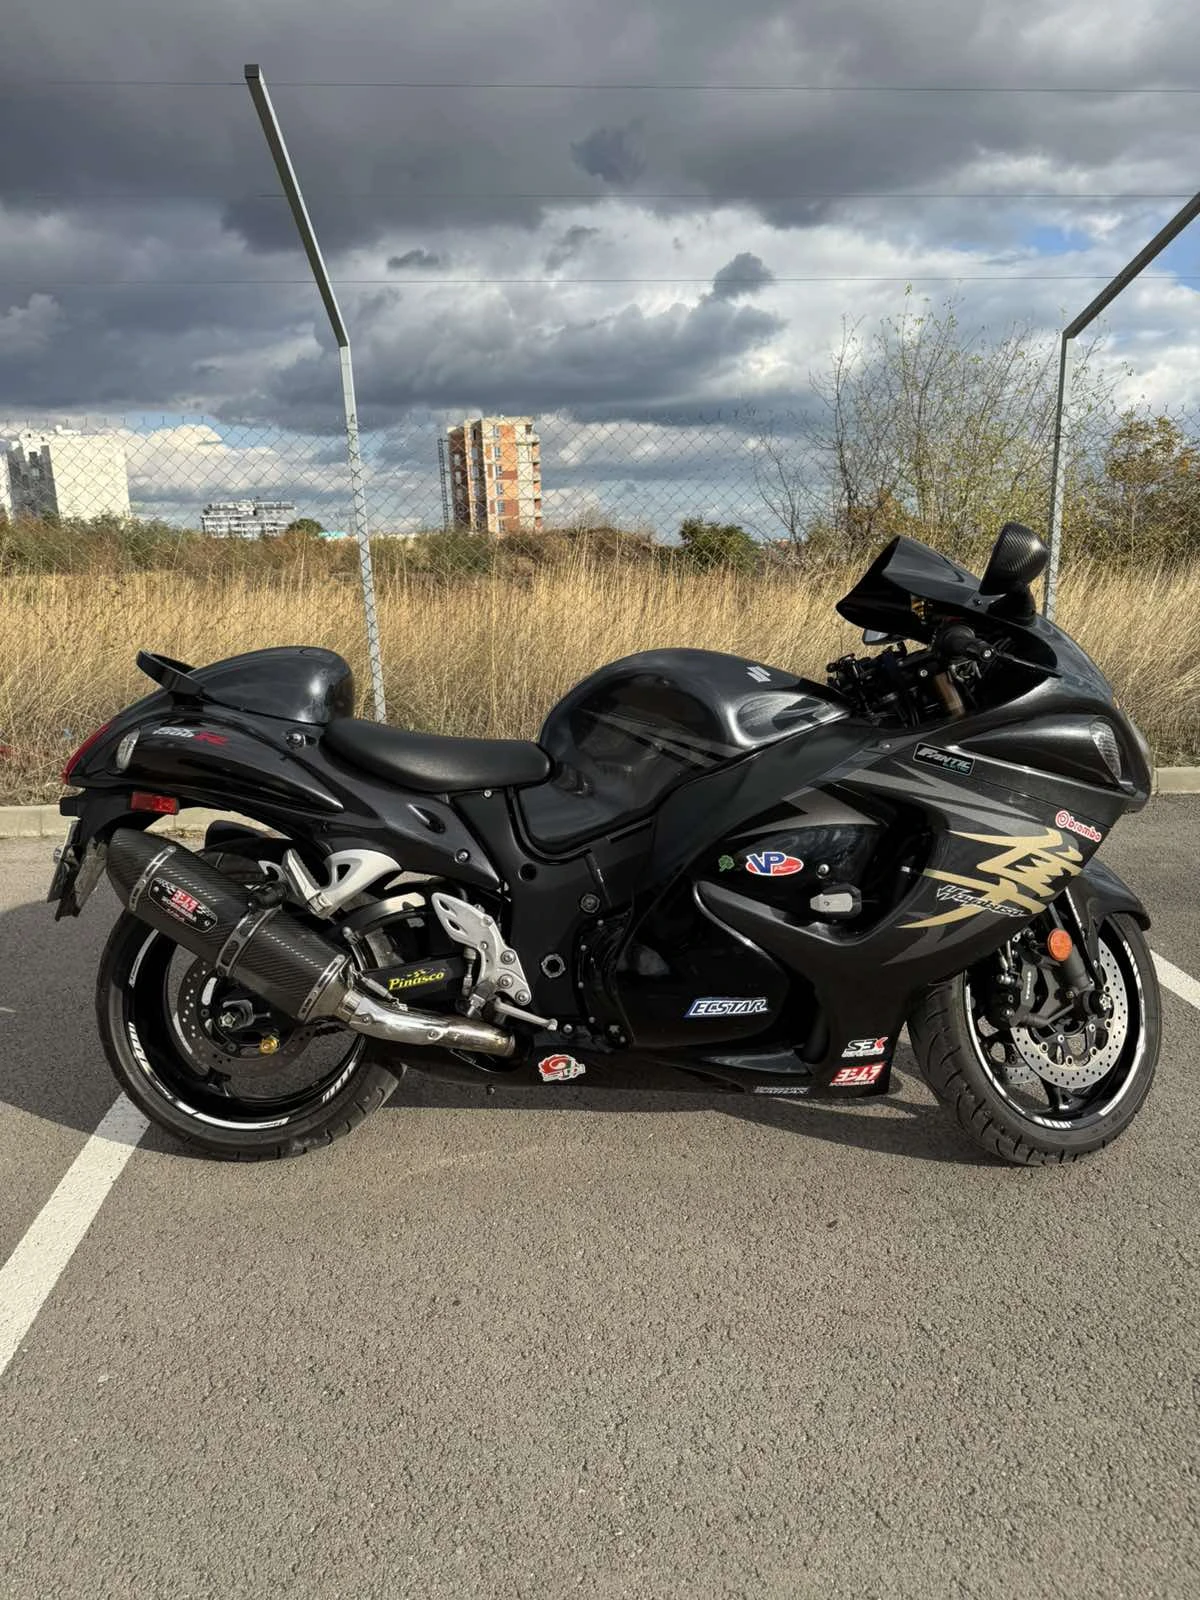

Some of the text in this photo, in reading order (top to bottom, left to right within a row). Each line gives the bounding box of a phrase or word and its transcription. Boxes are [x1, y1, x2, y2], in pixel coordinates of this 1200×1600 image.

[917, 747, 971, 769] FANTIC
[1067, 816, 1101, 842] brembo
[748, 852, 787, 875] VP
[389, 972, 445, 990] Pinasco
[688, 999, 768, 1015] ECSTAR
[834, 1063, 883, 1082] ヨシムラ
